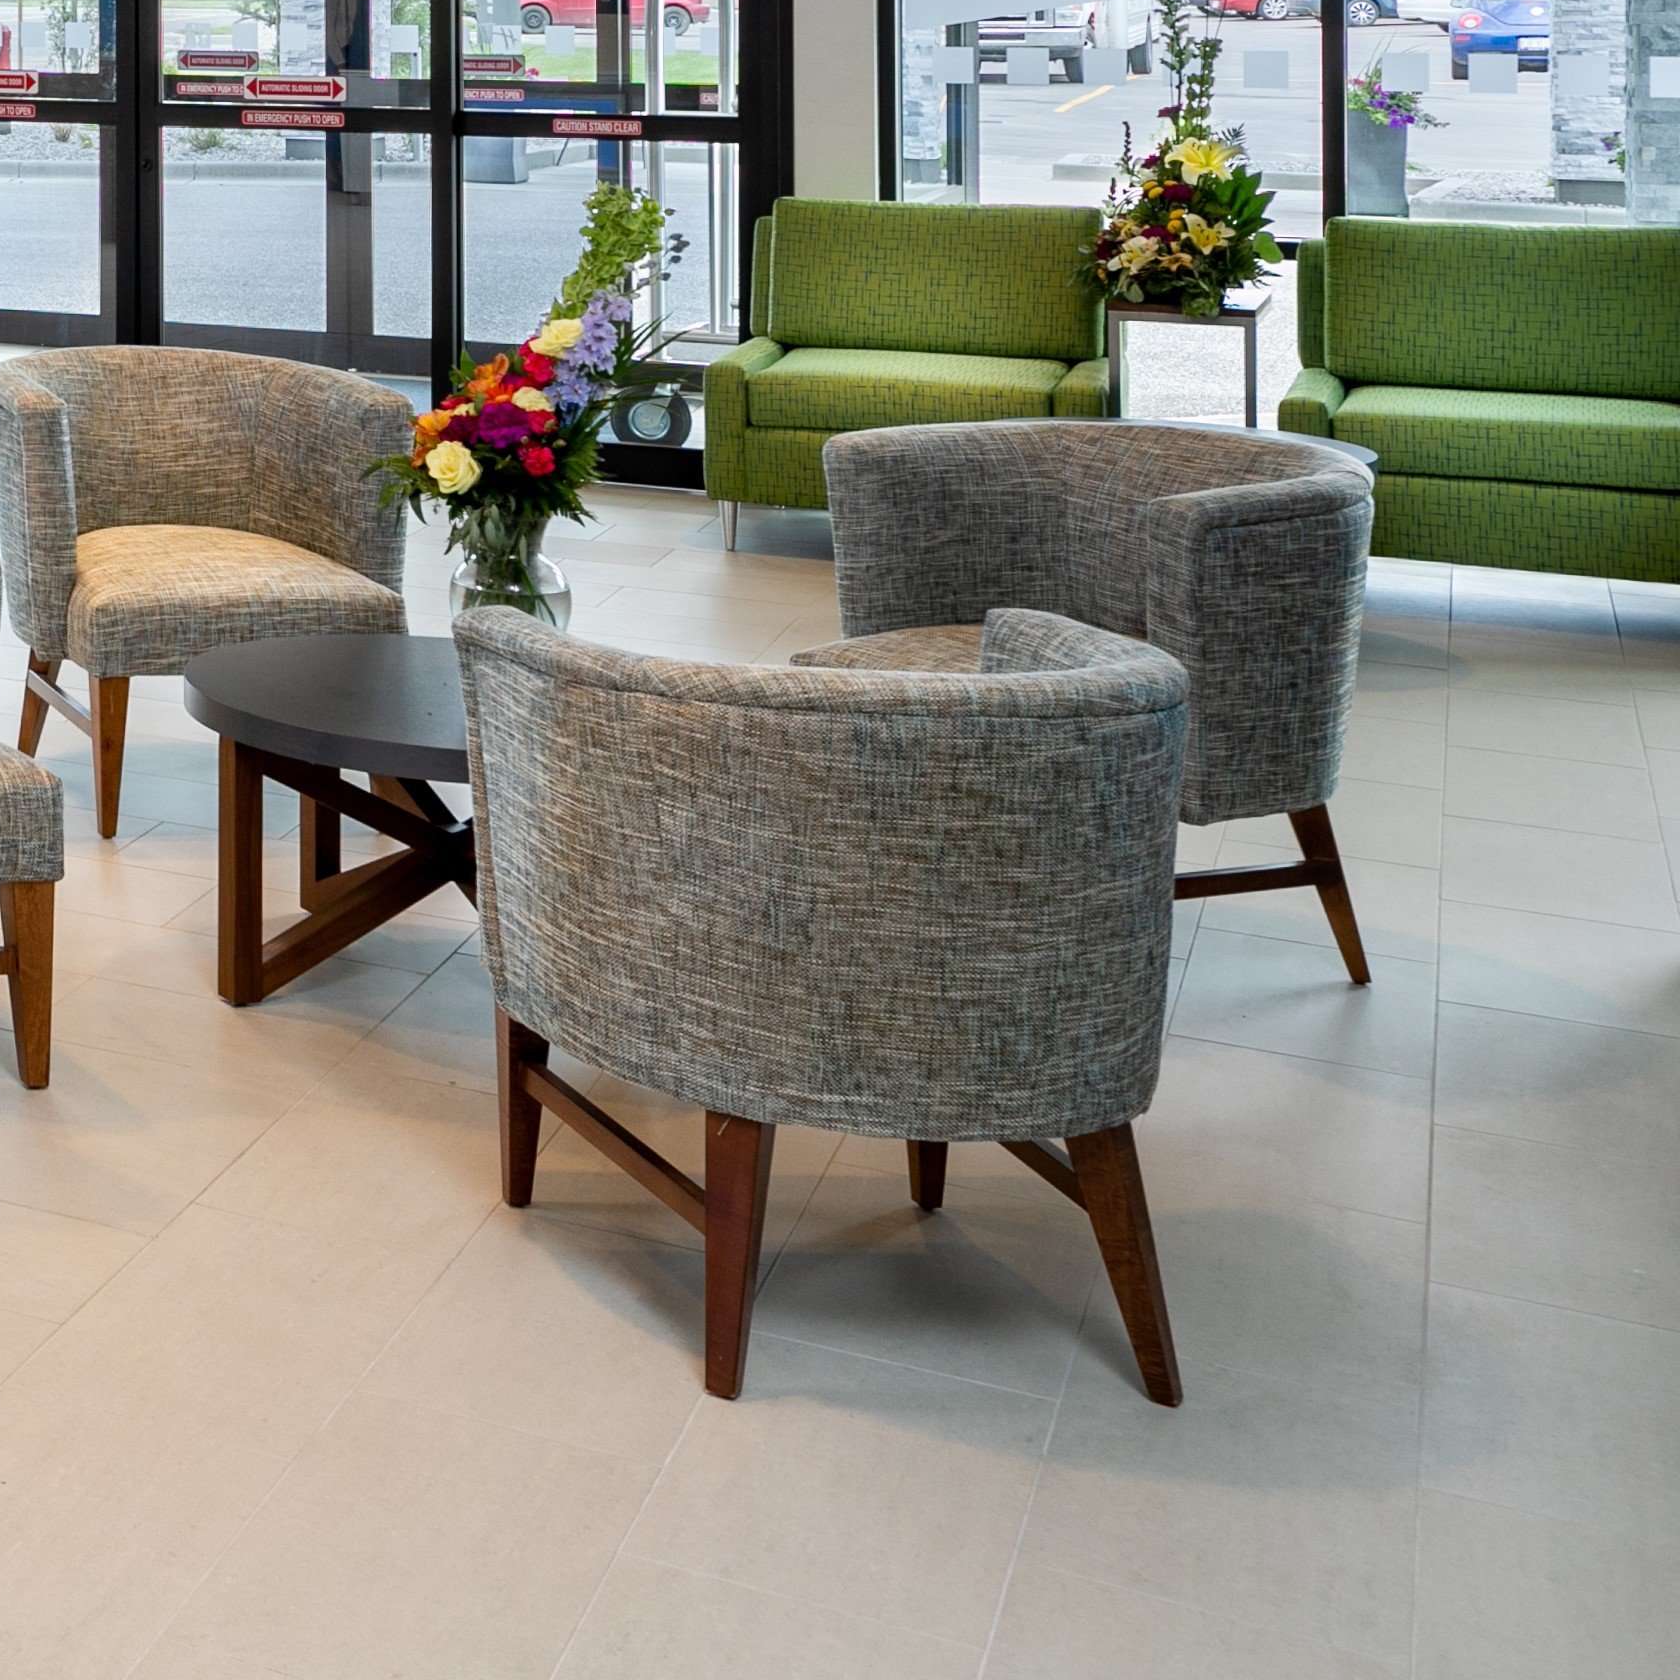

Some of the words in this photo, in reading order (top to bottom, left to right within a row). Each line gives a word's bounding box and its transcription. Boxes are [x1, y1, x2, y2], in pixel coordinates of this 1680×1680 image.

[8, 78, 23, 86] DOOR
[180, 84, 186, 92] IN
[187, 84, 217, 92] EMERGENCY
[217, 85, 232, 93] PUSH
[261, 84, 290, 92] AUTOMATIC
[291, 84, 312, 92] SLIDING
[313, 85, 329, 93] DOOR
[480, 90, 496, 99] PUSH
[496, 90, 504, 99] TO
[504, 90, 520, 99] OPEN
[6, 106, 15, 115] TO
[15, 107, 32, 116] OPEN
[246, 113, 254, 122] IN
[254, 113, 293, 123] EMERGENCY
[294, 114, 311, 124] PUSH
[312, 115, 321, 124] TO
[321, 115, 340, 125] OPEN
[556, 121, 587, 131] CAUTION
[588, 122, 613, 132] STAND
[614, 122, 639, 133] CLEAR
